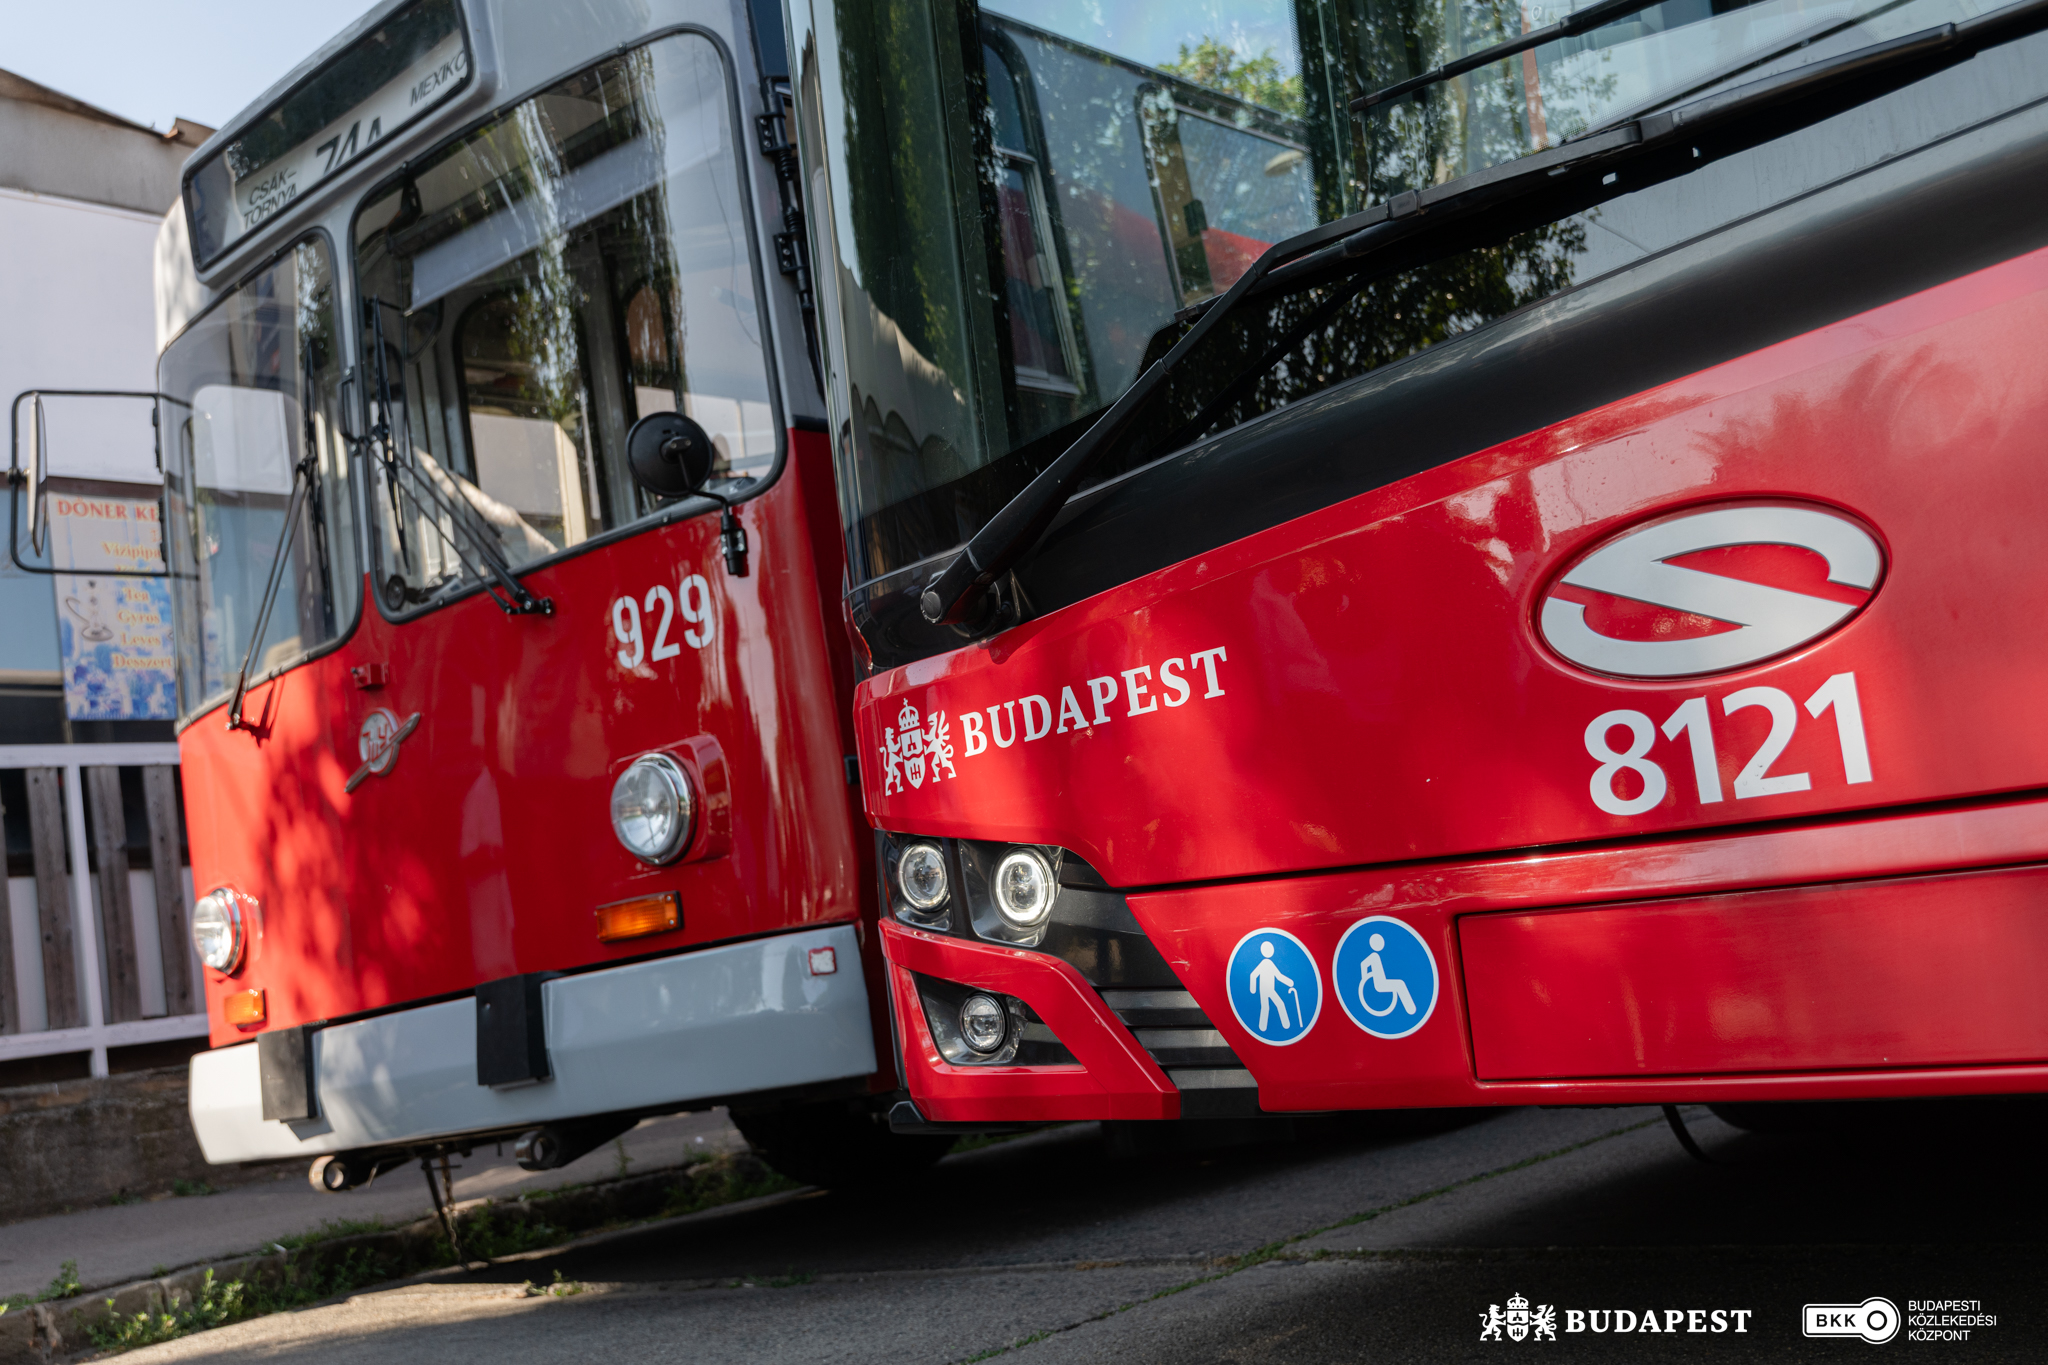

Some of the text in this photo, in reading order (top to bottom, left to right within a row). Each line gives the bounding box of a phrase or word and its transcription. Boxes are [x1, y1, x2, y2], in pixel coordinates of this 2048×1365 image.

[57, 497, 128, 519] DÖNER
[121, 632, 161, 646] Leves
[612, 574, 715, 669] 929
[960, 646, 1227, 758] BUDAPEST
[1584, 671, 1872, 816] 8121
